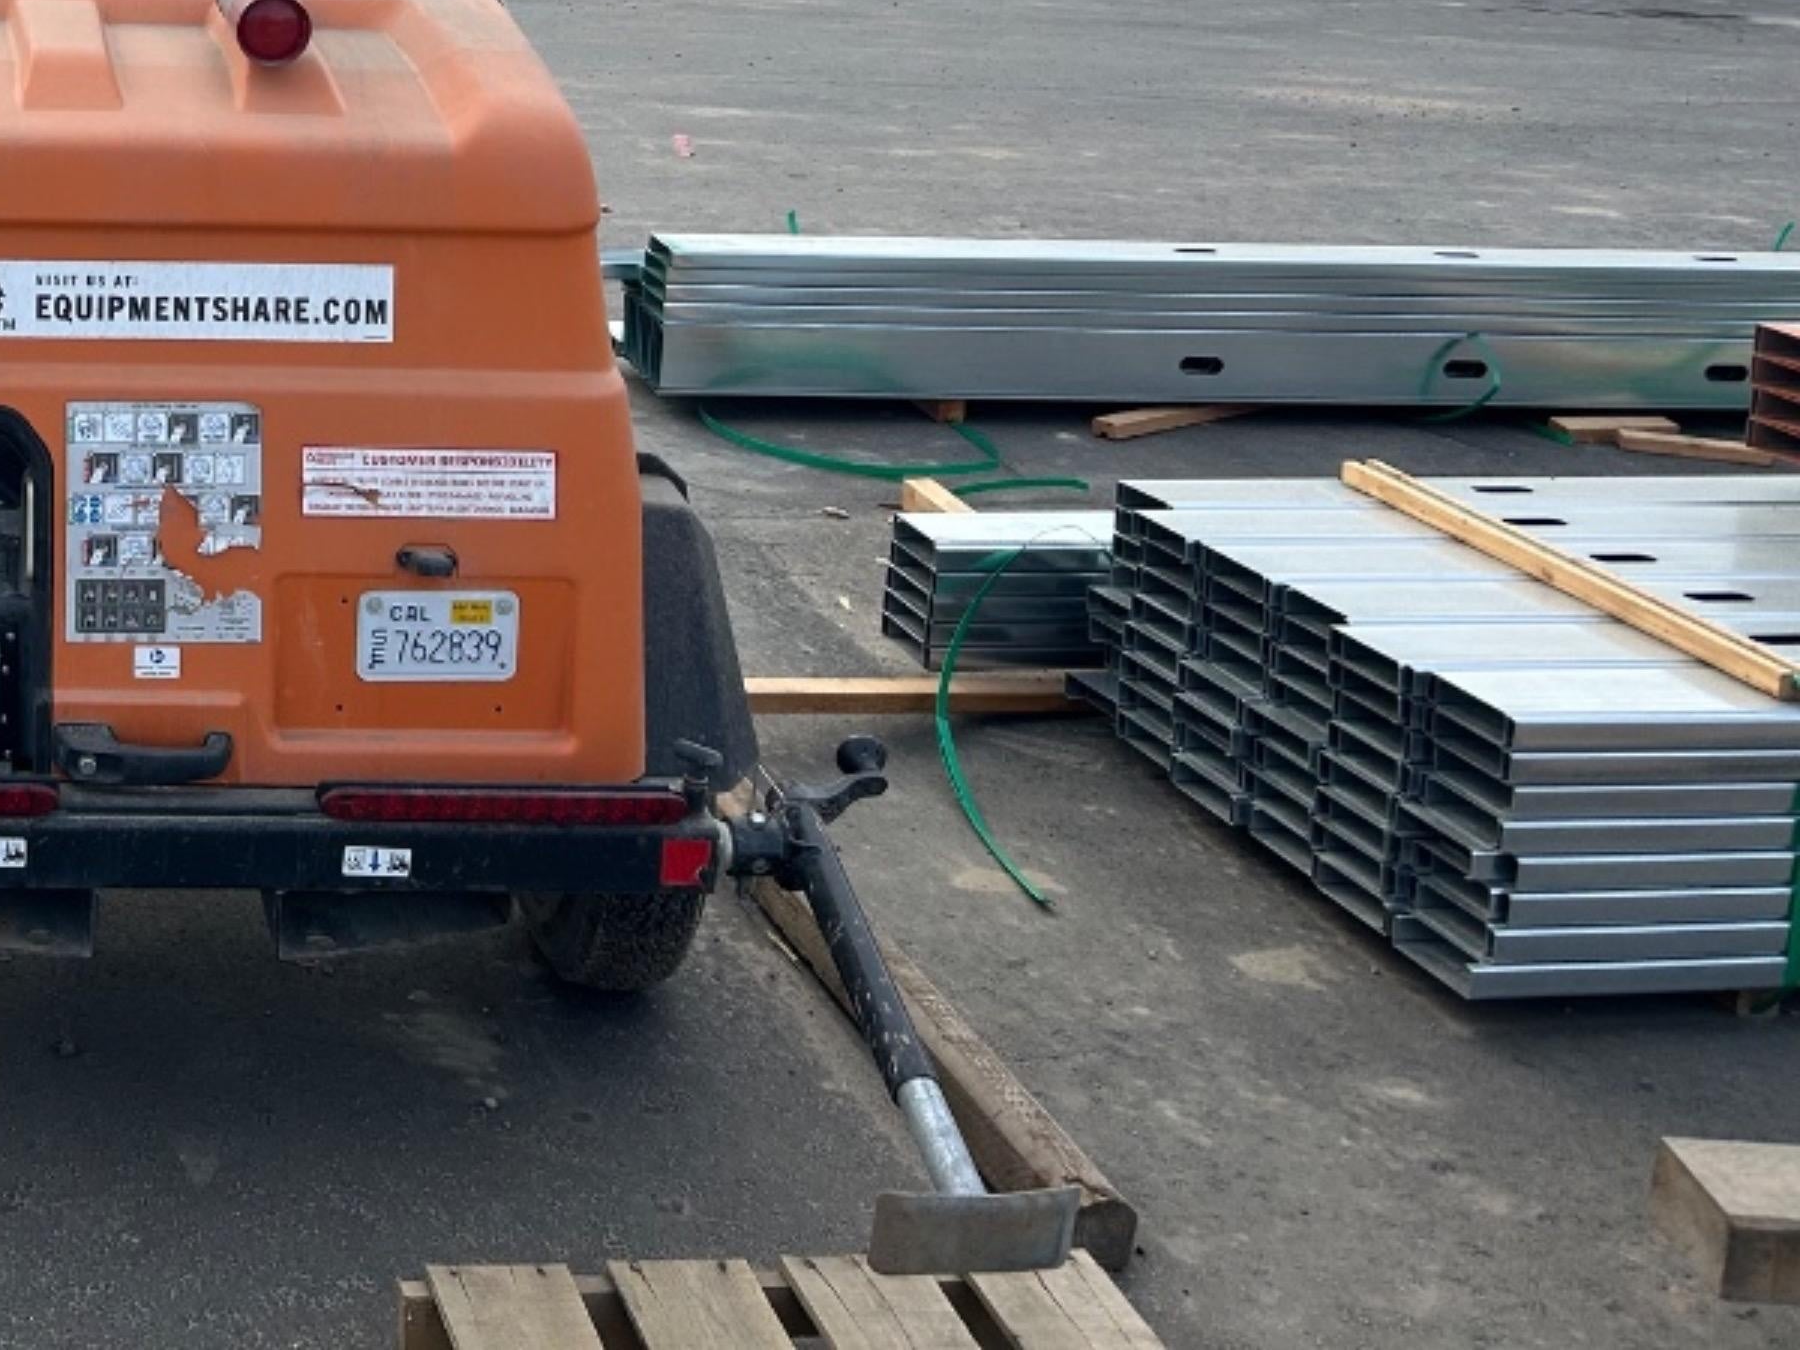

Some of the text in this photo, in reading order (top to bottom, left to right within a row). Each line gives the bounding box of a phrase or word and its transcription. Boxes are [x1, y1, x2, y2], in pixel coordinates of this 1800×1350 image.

[35, 274, 77, 287] VISIT
[85, 275, 105, 288] US
[36, 293, 388, 326] EQUIPMENTSHARE.COM
[388, 604, 432, 623] CAL
[394, 628, 504, 666] 762839
